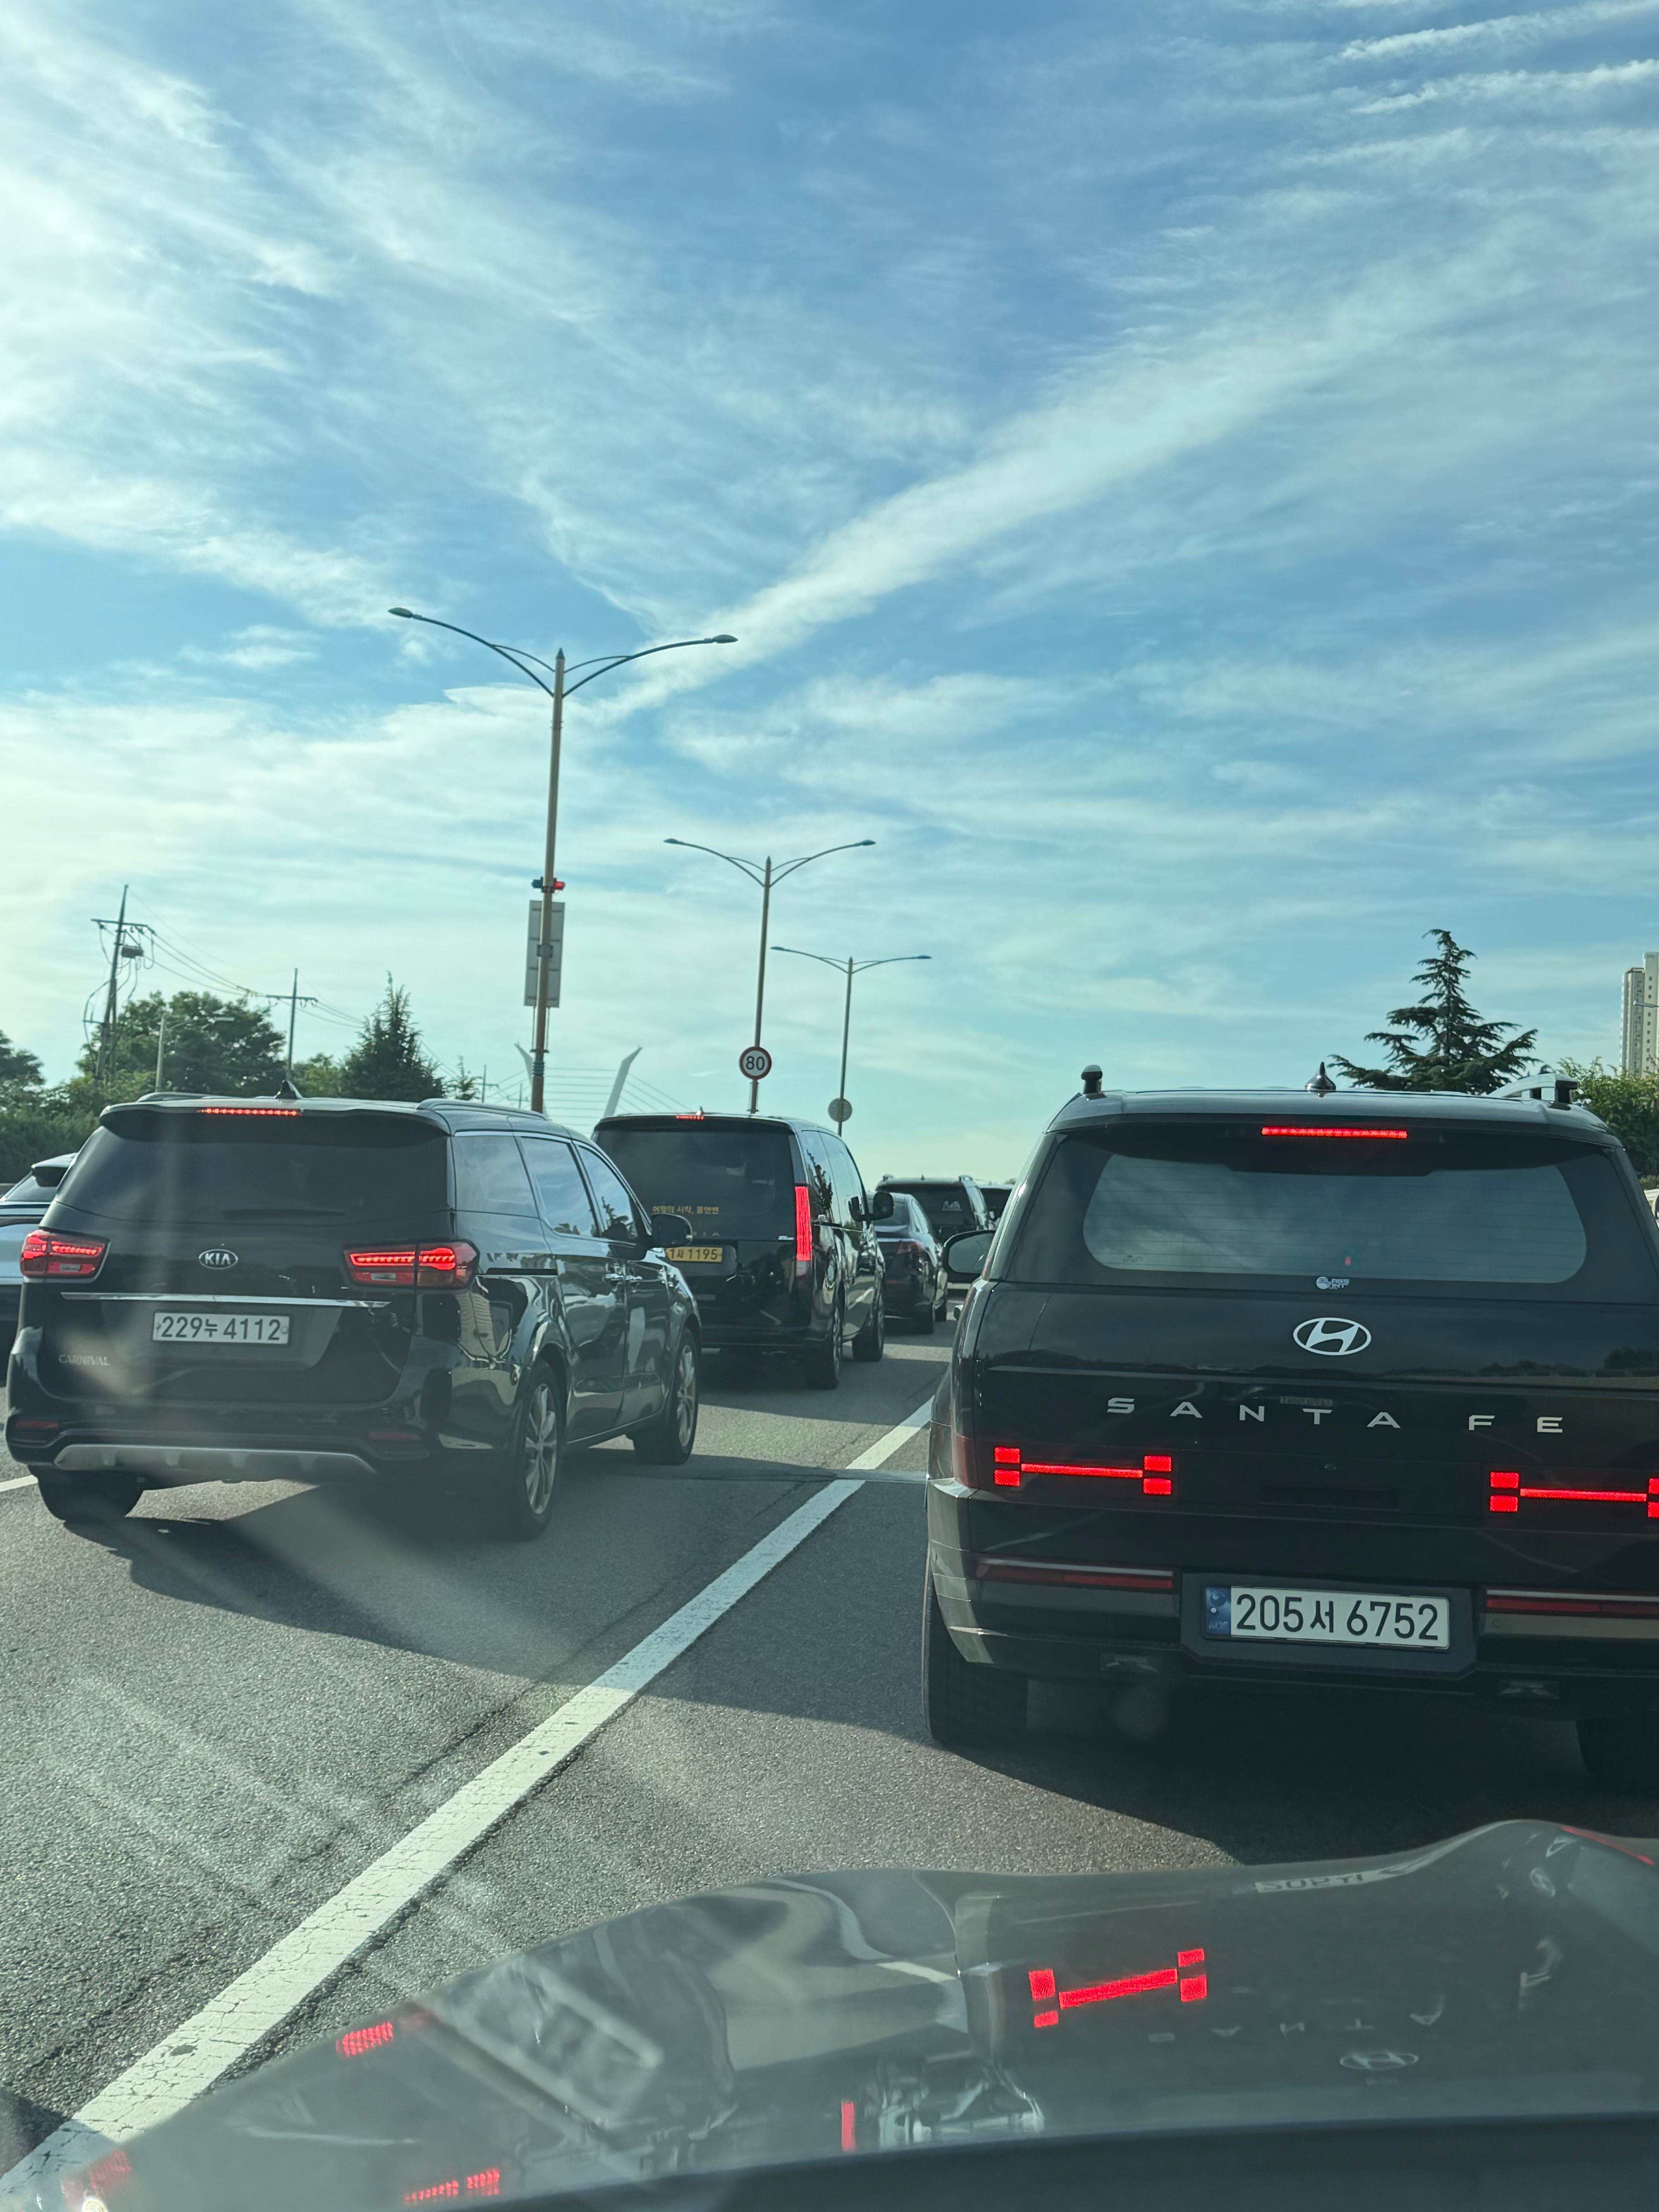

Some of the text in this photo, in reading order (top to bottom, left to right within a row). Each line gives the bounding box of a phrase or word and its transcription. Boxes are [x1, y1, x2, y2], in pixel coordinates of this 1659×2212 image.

[746, 1056, 764, 1070] 80
[205, 1253, 231, 1265] KIA
[688, 1249, 718, 1260] 1195
[161, 1316, 281, 1340] 229누 4112
[1107, 1397, 1401, 1429] SANTA
[1468, 1415, 1563, 1433] FE
[1236, 1594, 1438, 1641] 205서 6752
